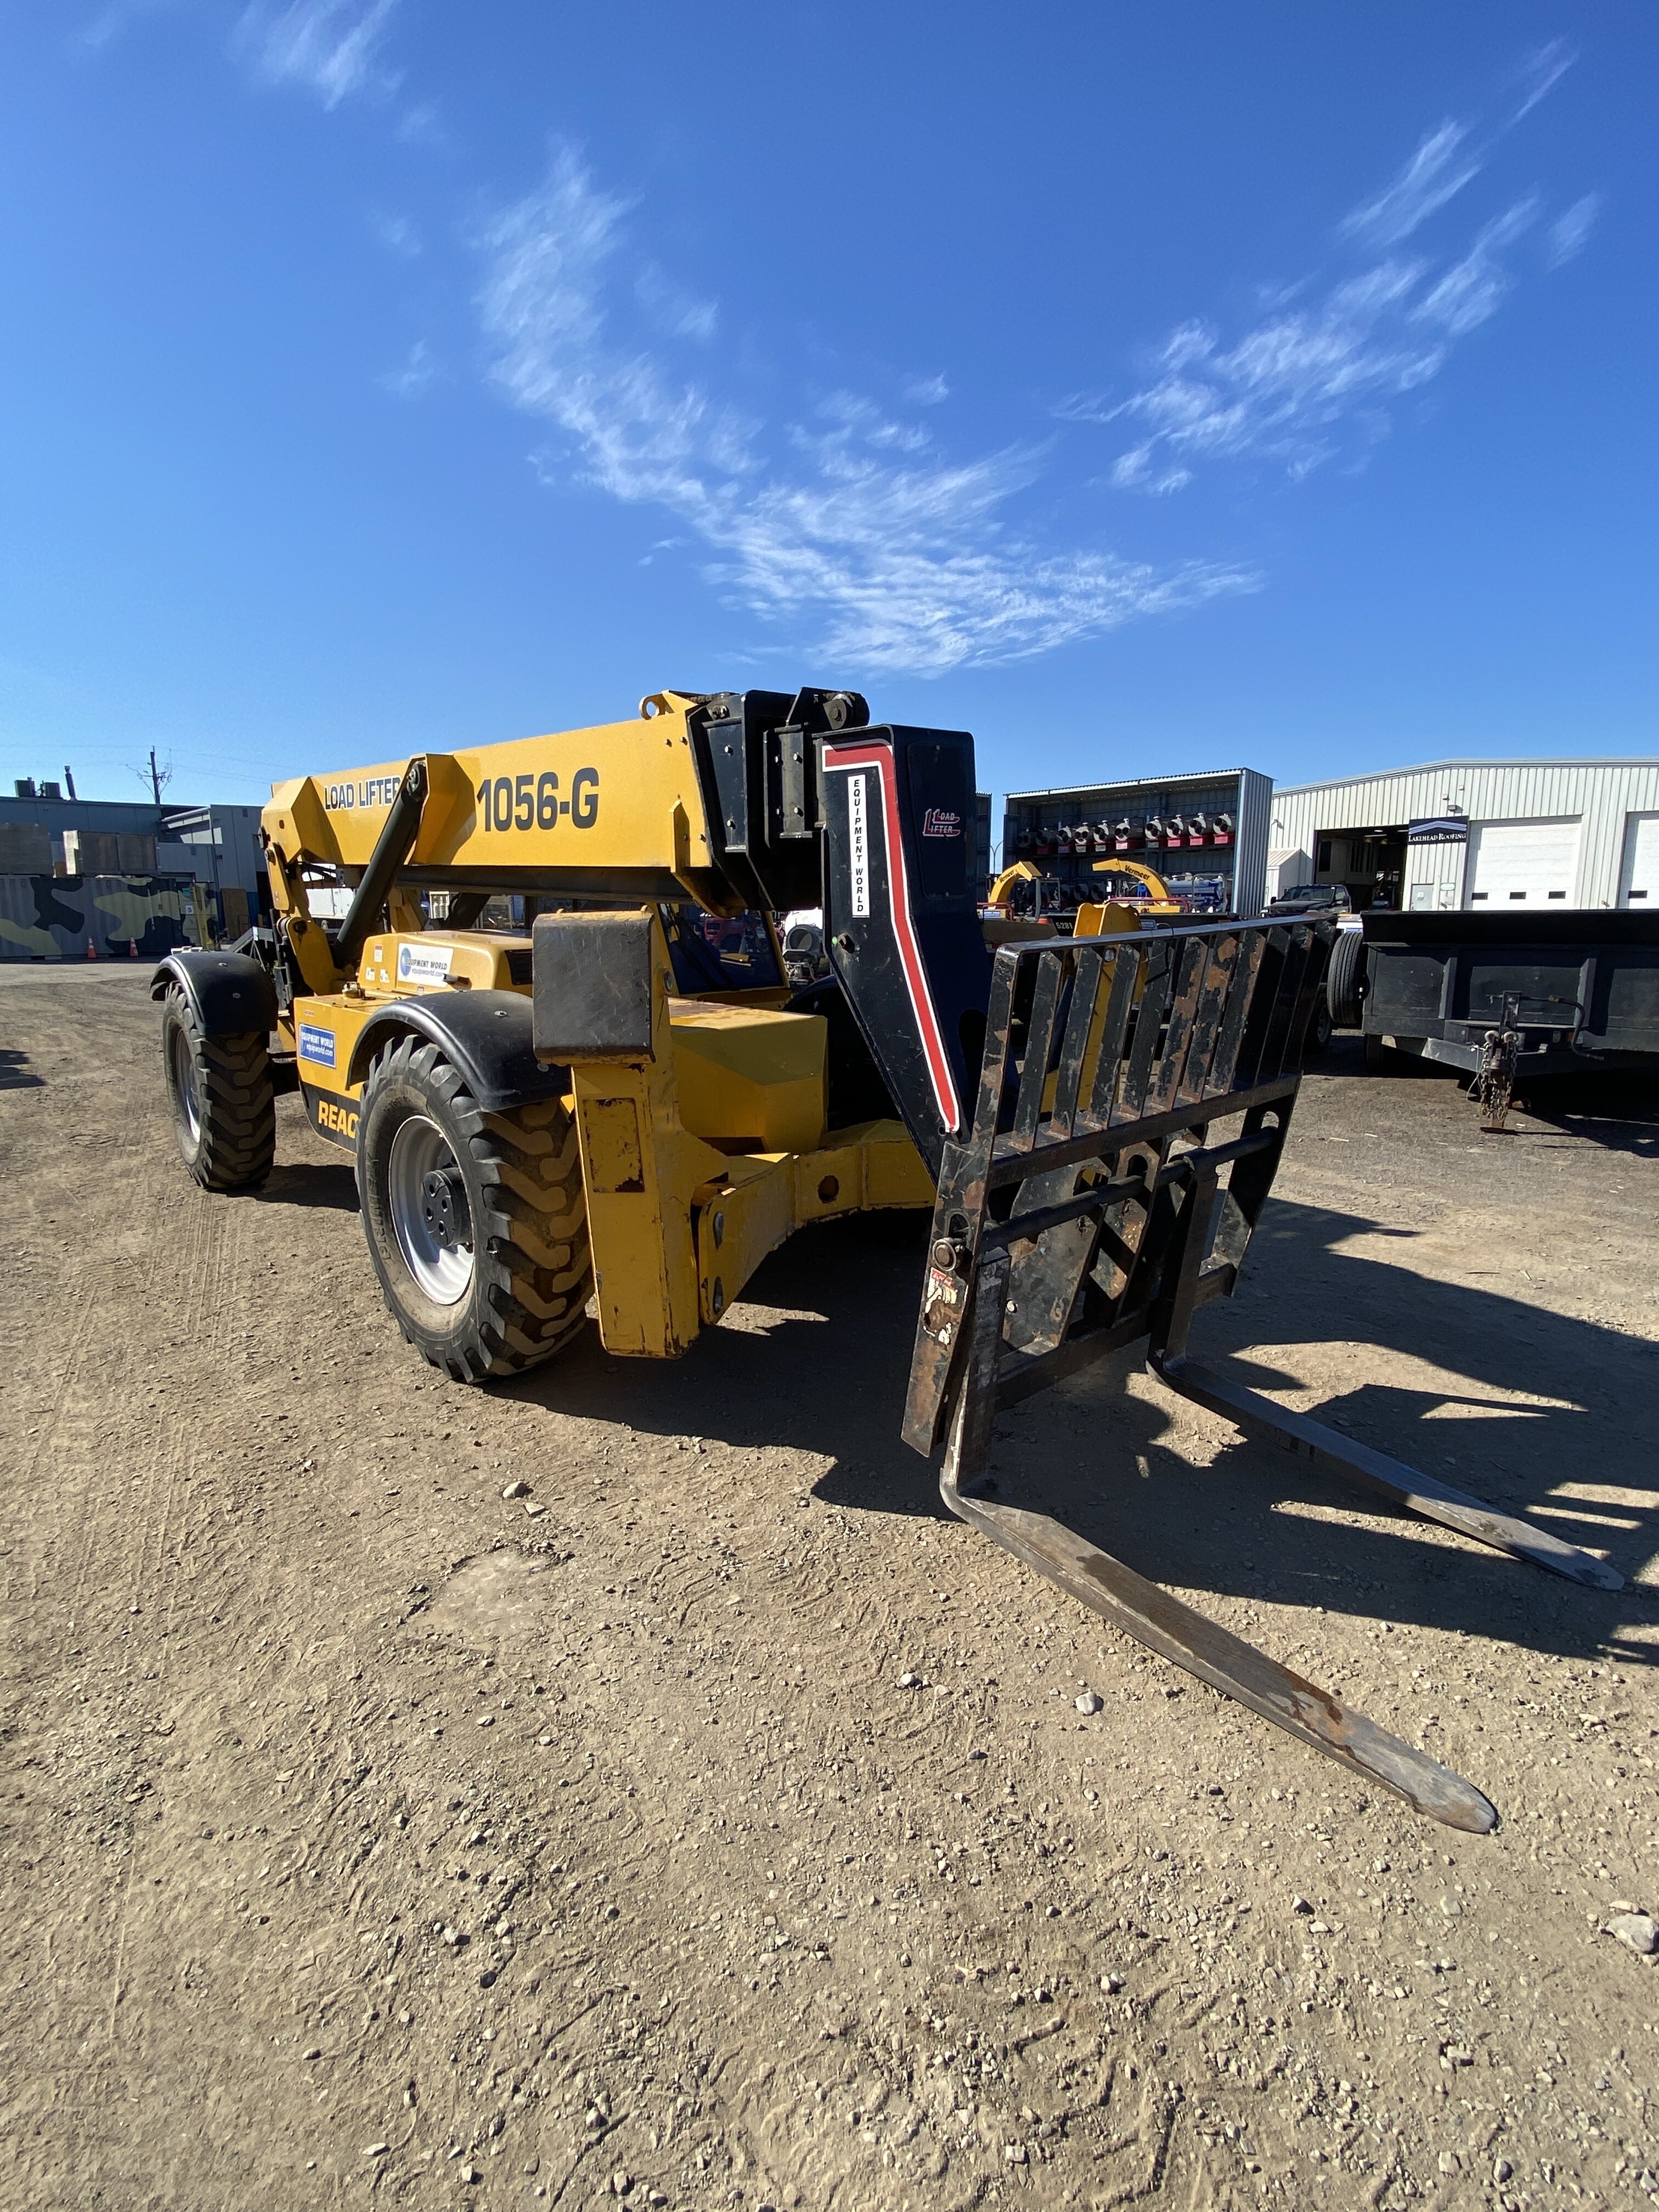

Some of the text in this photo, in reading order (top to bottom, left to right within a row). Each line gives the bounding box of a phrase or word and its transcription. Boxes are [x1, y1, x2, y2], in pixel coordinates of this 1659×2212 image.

[324, 783, 354, 810] LOAD
[476, 767, 599, 832] 1056-G
[922, 808, 961, 837] LIFTER
[932, 808, 960, 824] LOAD
[854, 779, 864, 912] EQUIPMENT WORLD
[1125, 865, 1150, 881] Vermeer
[431, 961, 448, 970] WORLD
[320, 1036, 334, 1048] WORLD
